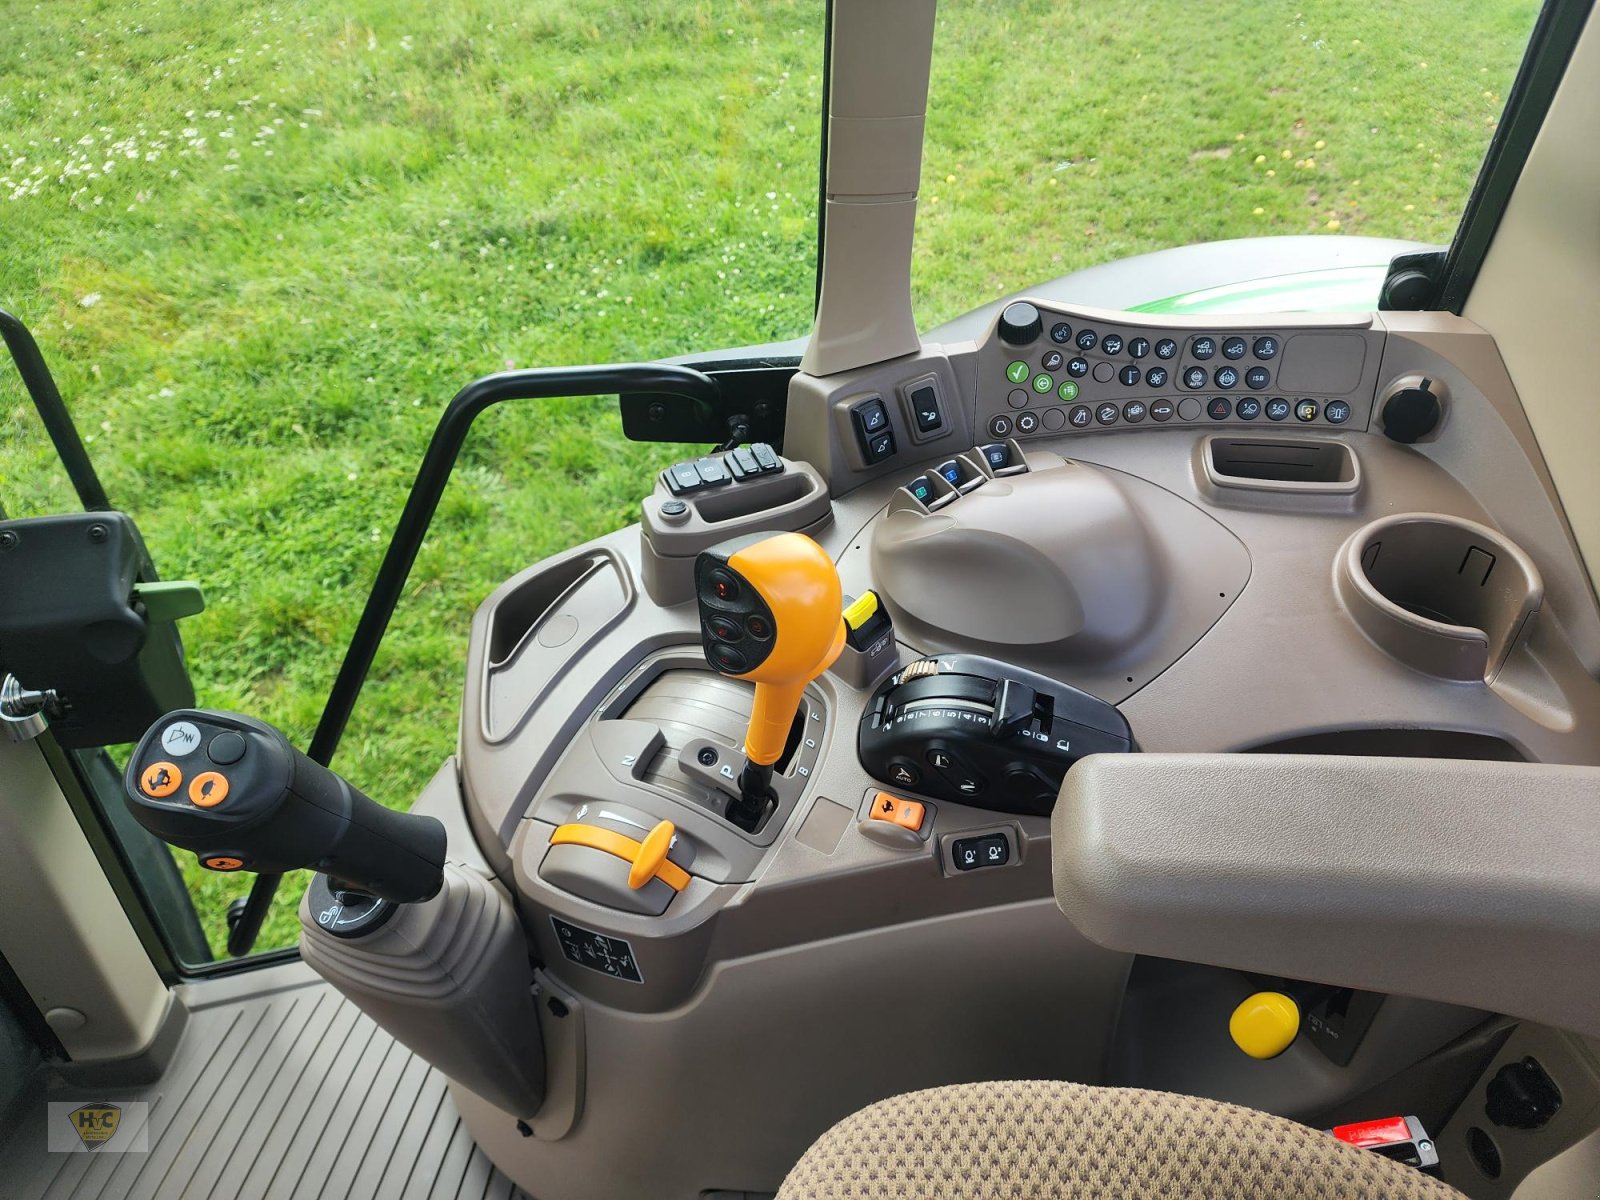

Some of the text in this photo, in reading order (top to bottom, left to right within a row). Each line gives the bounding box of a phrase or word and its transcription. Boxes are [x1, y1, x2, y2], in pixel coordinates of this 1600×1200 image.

[811, 712, 821, 722] F
[977, 716, 987, 724] 3
[806, 739, 816, 749] D
[621, 755, 636, 767] N
[719, 765, 734, 779] P
[798, 766, 809, 777] B
[895, 775, 912, 783] AUTO
